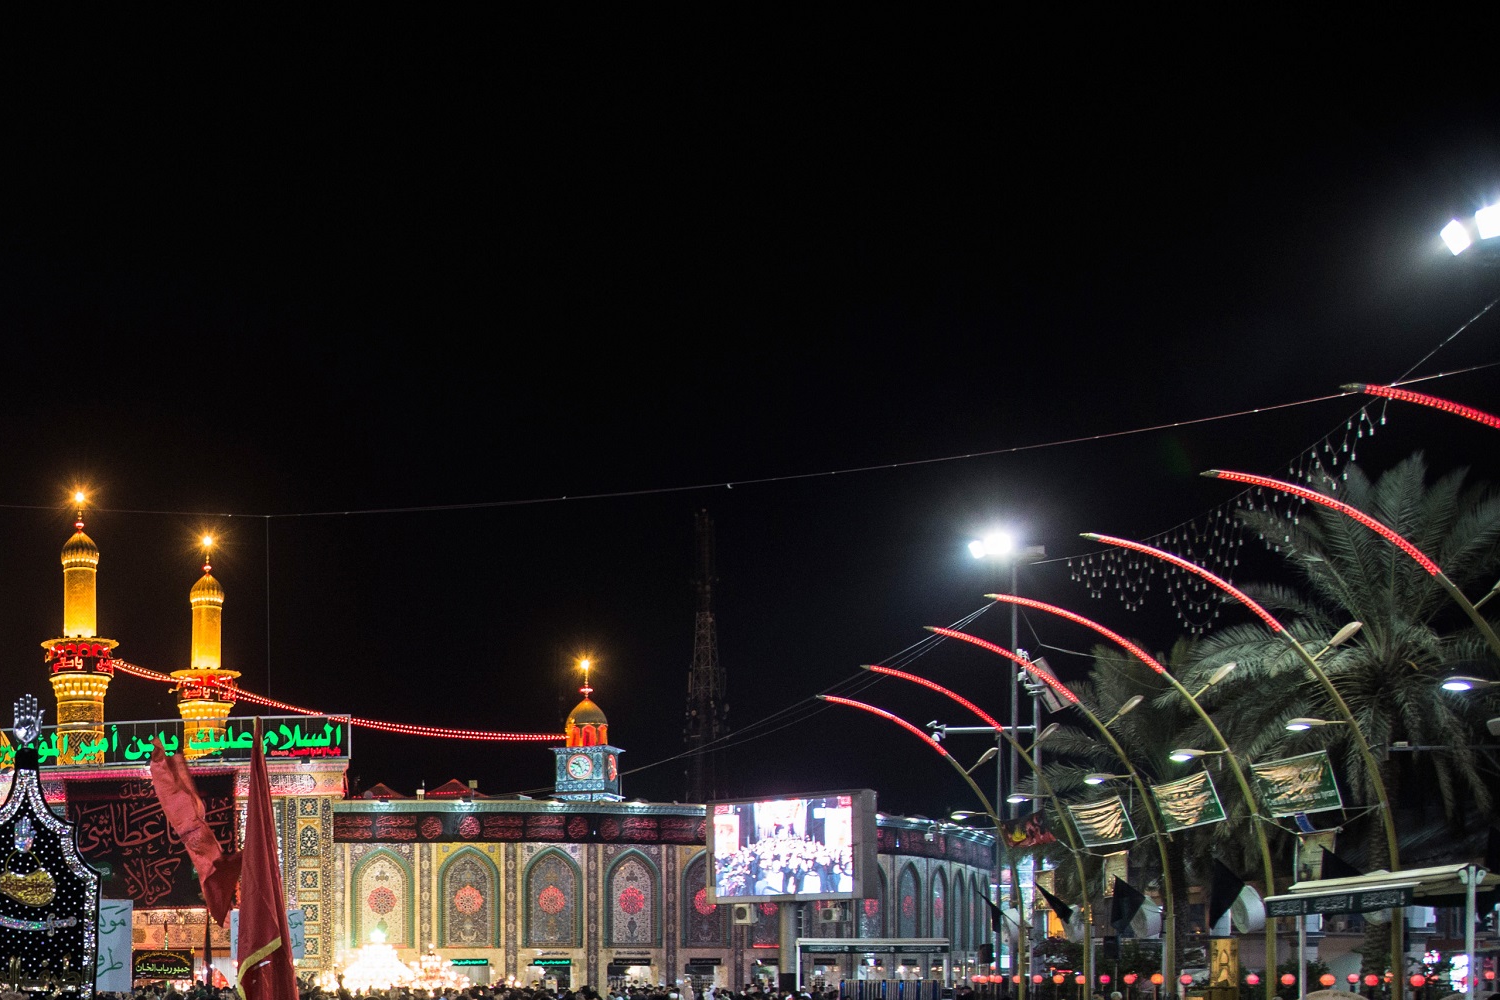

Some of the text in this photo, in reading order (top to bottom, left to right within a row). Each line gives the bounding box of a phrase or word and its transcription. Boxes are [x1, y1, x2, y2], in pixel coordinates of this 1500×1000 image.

[72, 724, 118, 761] أمير
[189, 726, 254, 756] عليك
[262, 723, 342, 755] السلام
[122, 857, 181, 905] كربلاء
